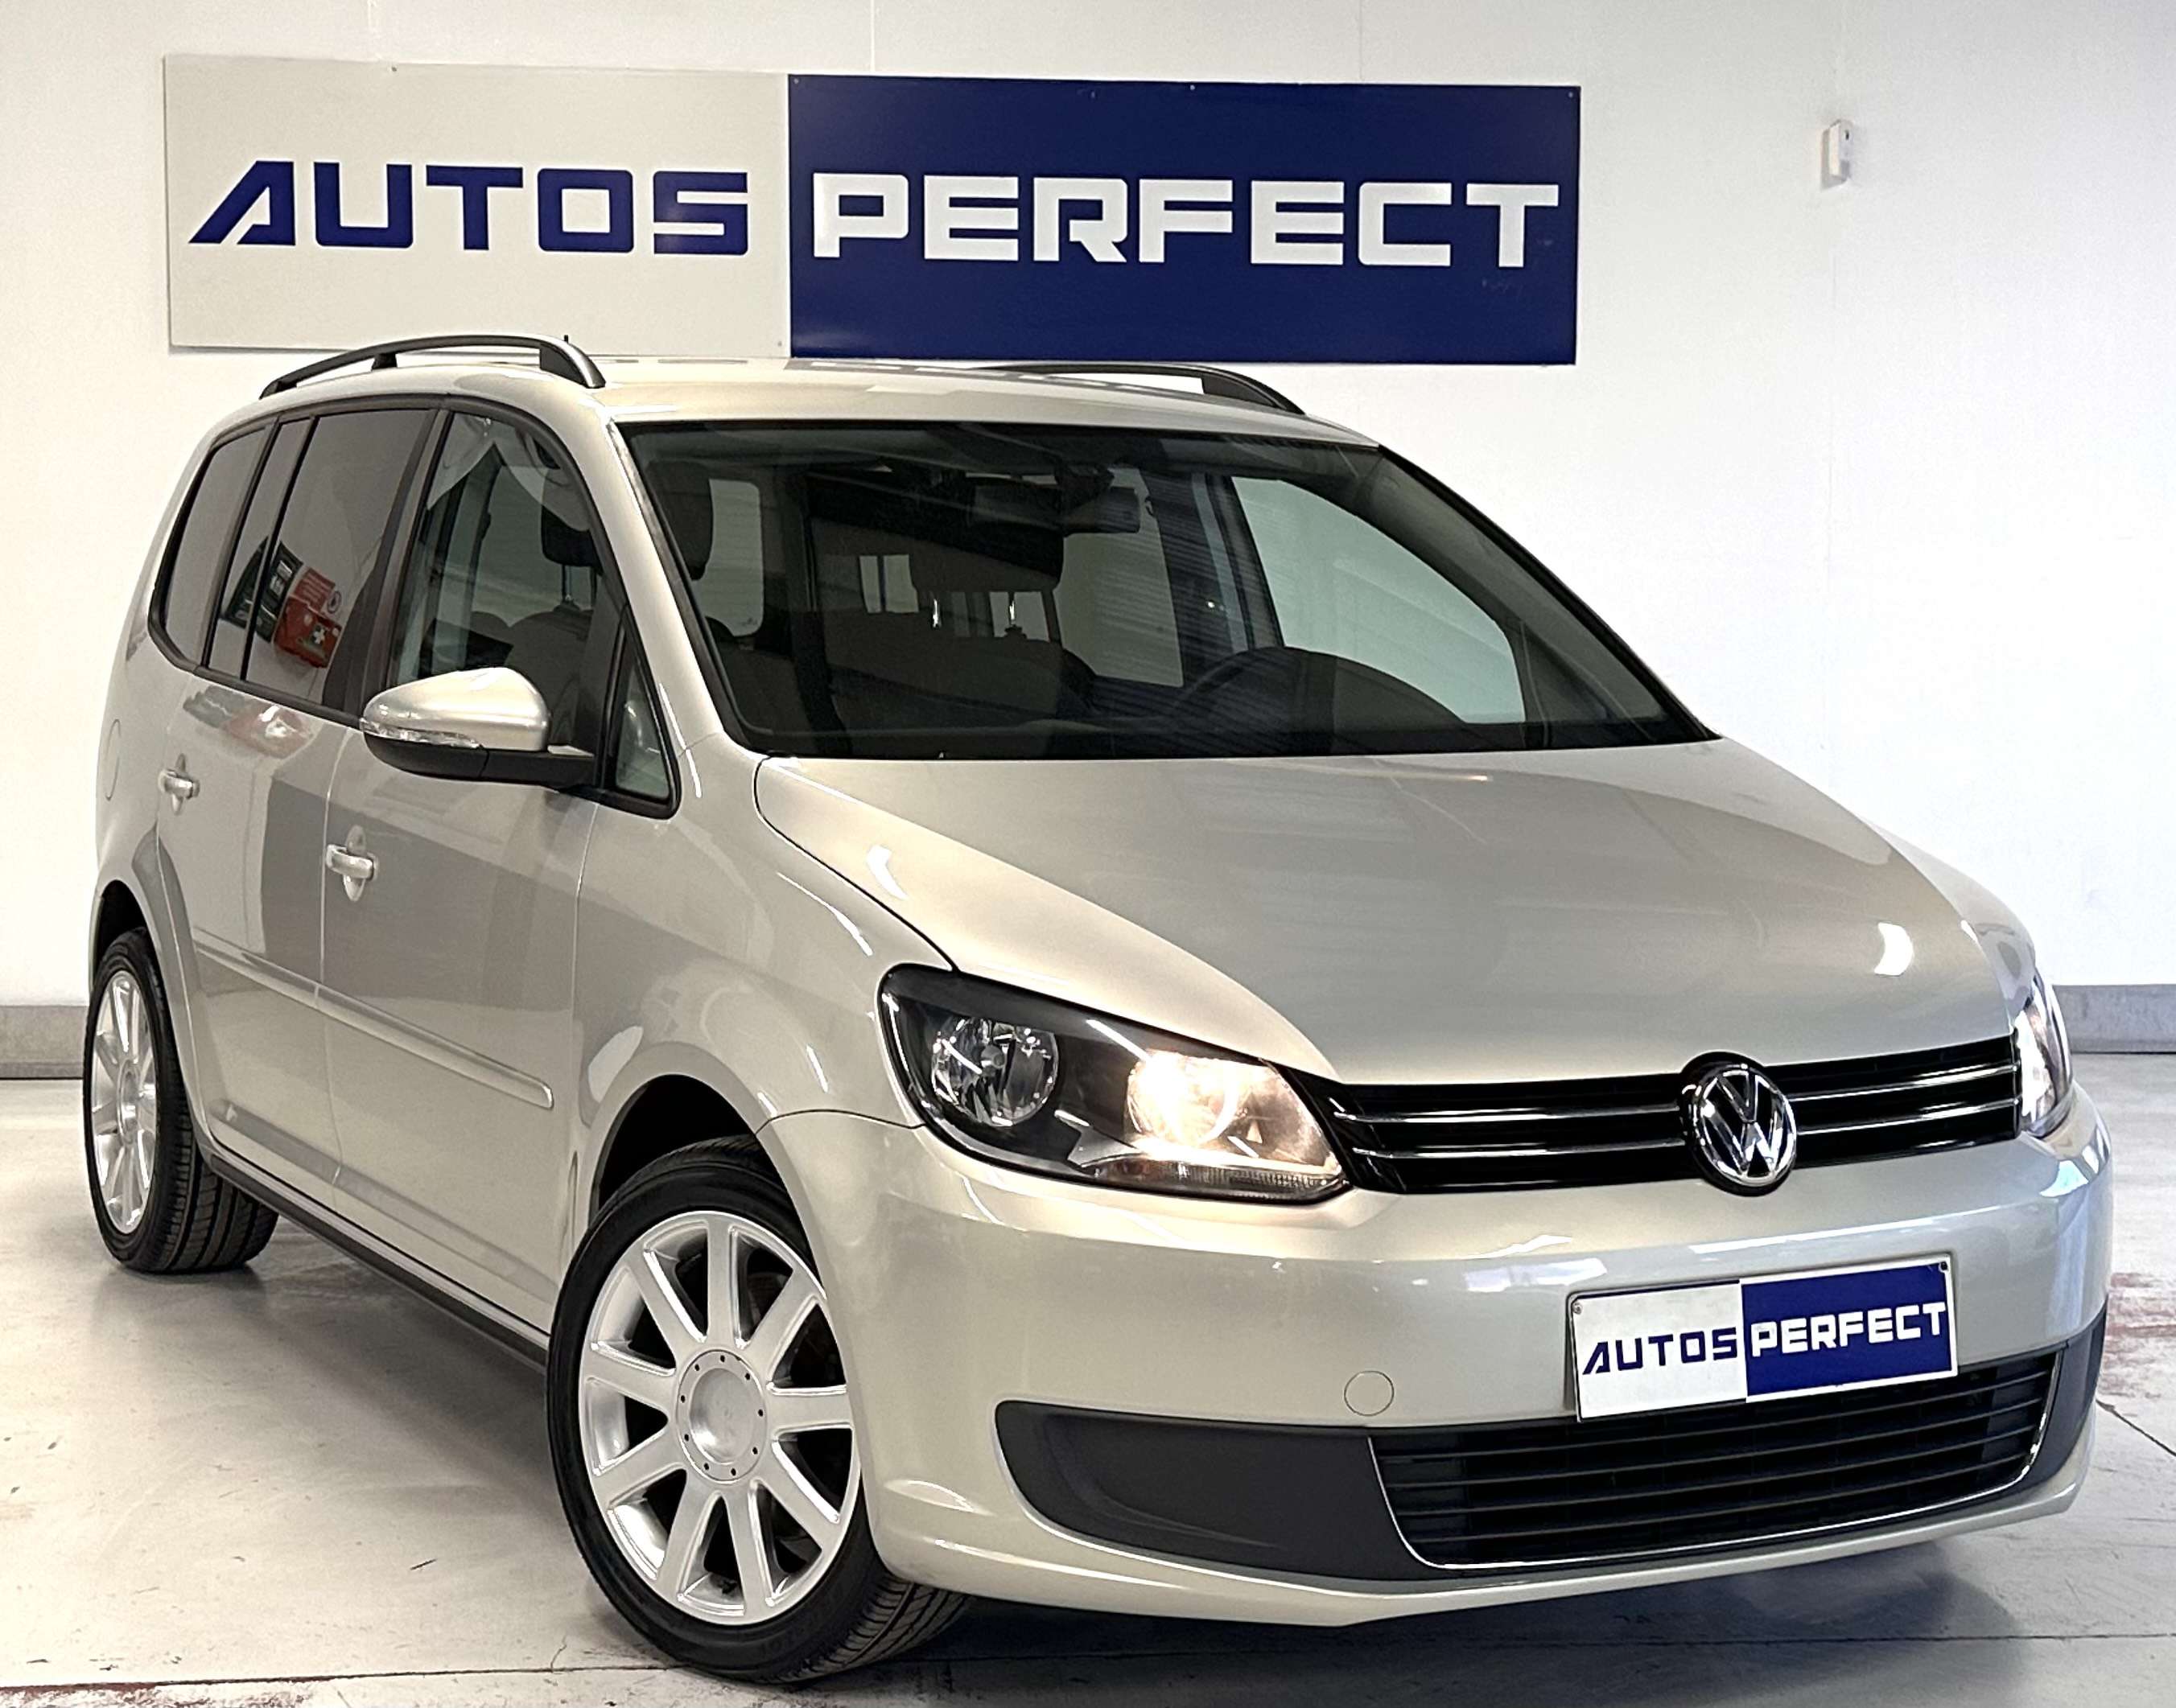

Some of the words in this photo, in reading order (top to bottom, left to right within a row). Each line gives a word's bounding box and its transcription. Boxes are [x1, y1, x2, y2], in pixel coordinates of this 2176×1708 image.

[188, 161, 748, 255] AUTOS
[813, 172, 1560, 268] PERFECT
[1582, 1327, 1738, 1375] AUTOS
[1750, 1302, 1946, 1358] PERFECT
